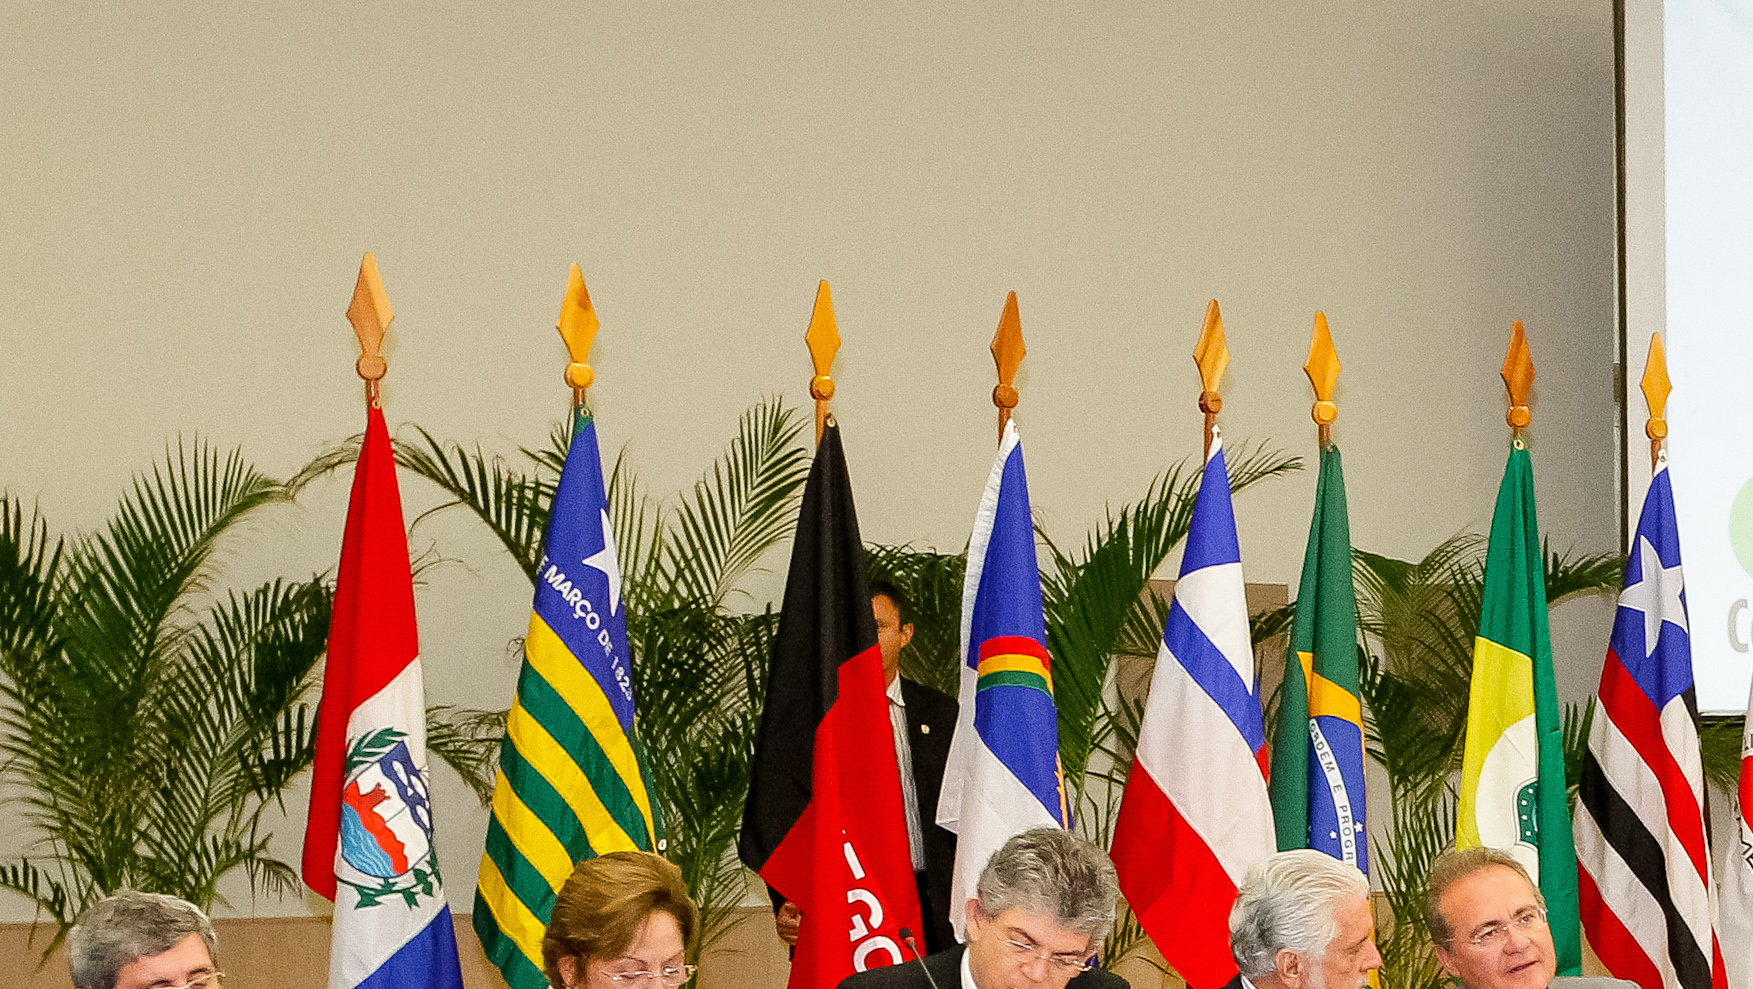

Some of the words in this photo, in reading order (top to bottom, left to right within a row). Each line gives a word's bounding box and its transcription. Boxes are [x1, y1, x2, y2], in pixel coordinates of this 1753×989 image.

[544, 564, 600, 630] MARÇO
[1309, 719, 1336, 774] ORDEM
[1333, 784, 1343, 793] E
[1339, 805, 1354, 862] PROGR
